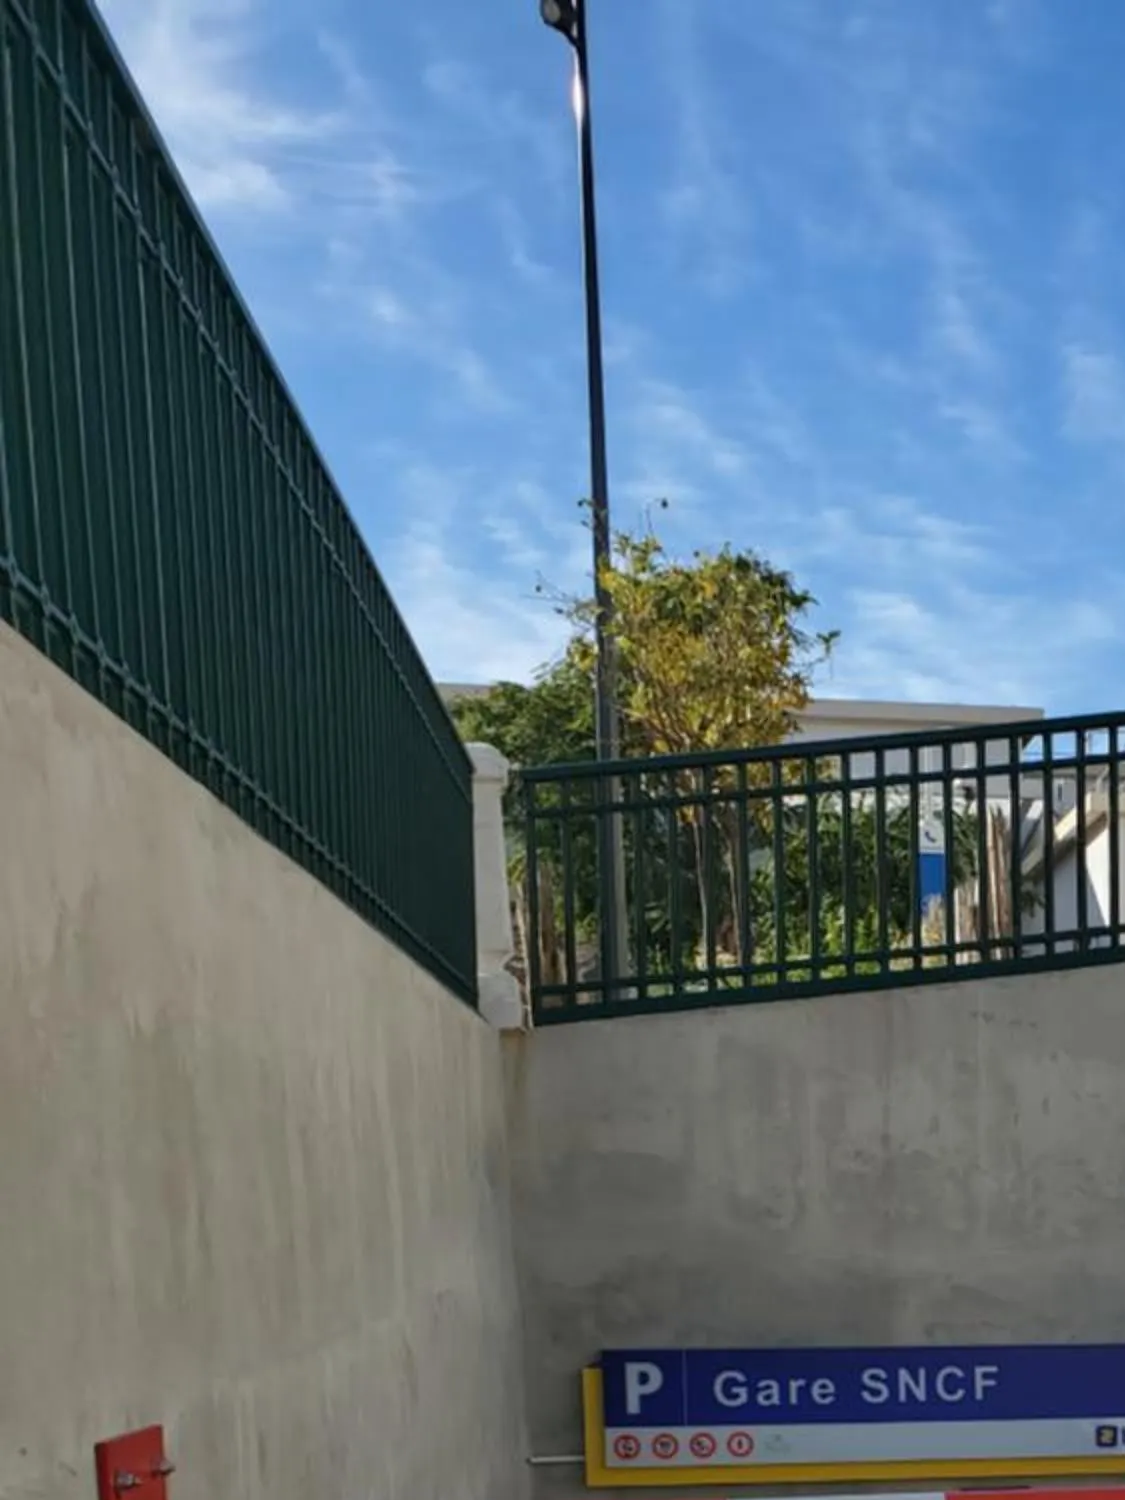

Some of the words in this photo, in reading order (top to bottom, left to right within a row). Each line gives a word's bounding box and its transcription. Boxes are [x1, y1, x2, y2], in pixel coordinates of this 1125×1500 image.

[624, 1361, 664, 1415] P
[713, 1369, 837, 1407] Gare
[861, 1365, 999, 1404] SNCF
